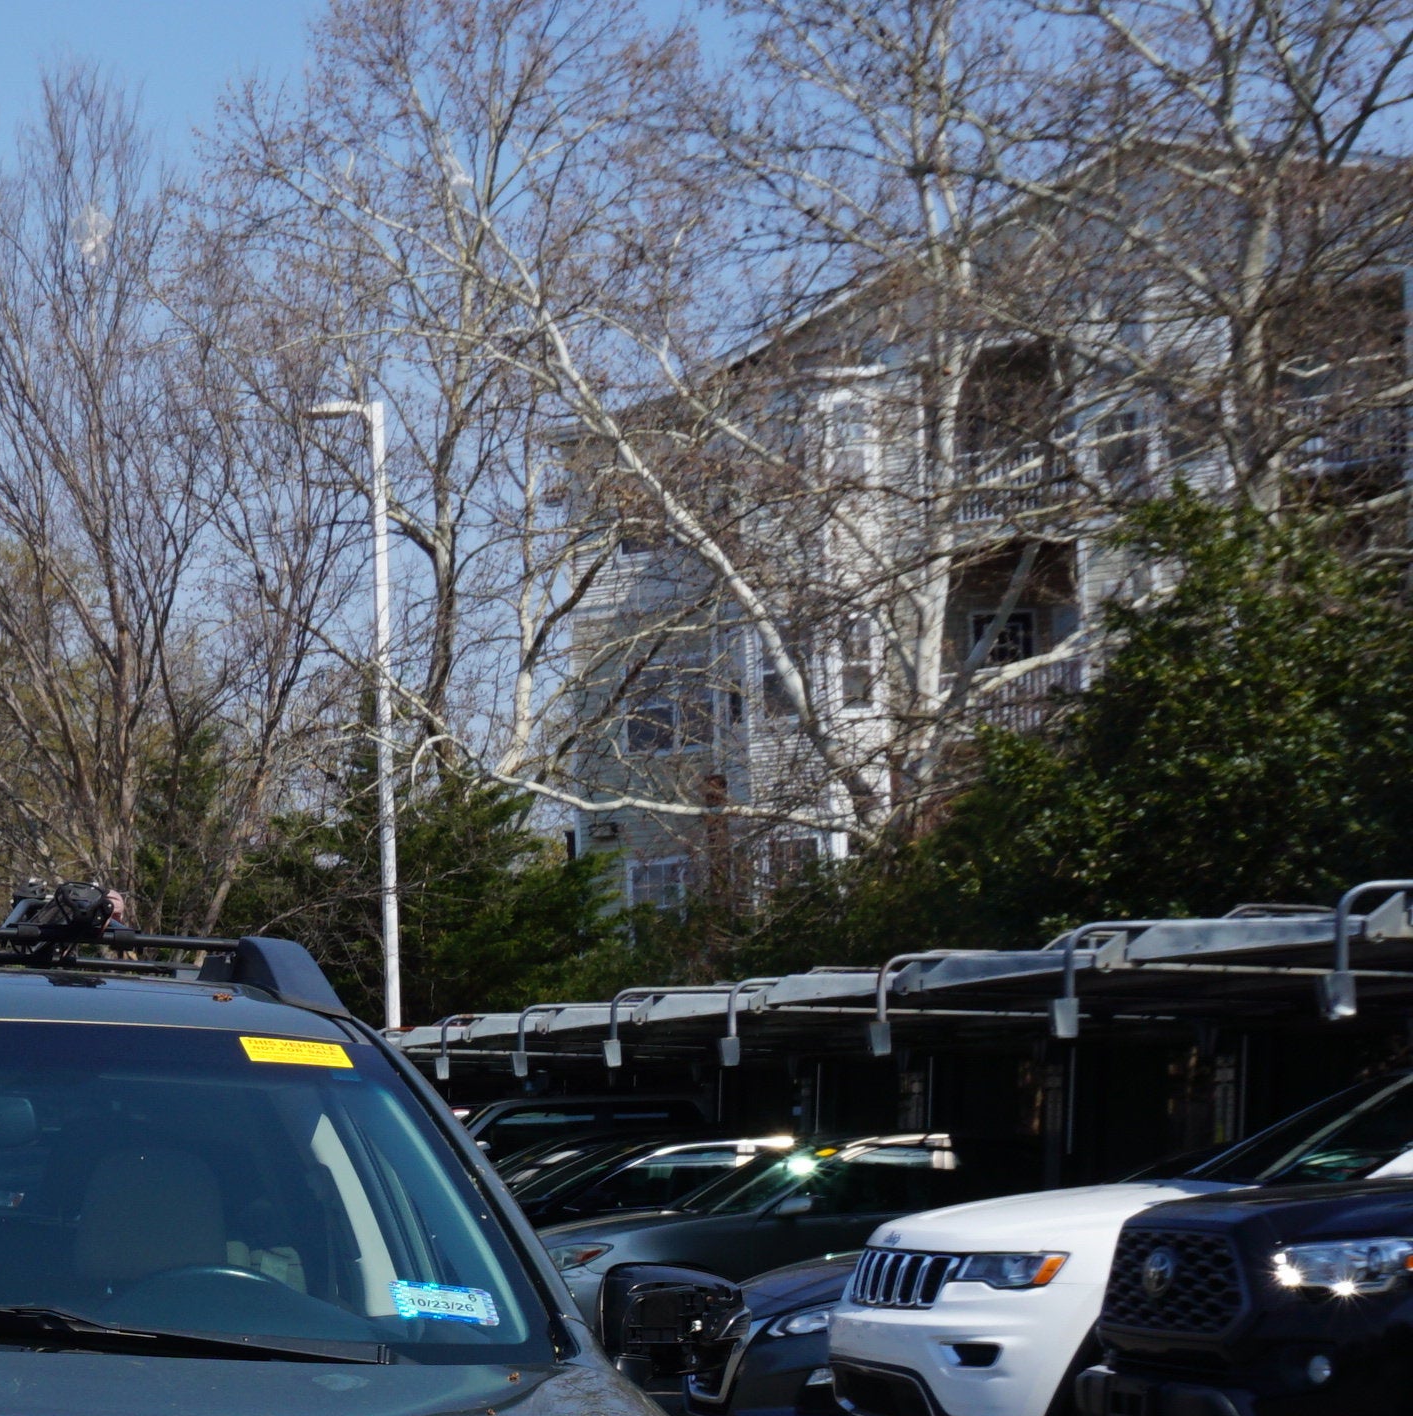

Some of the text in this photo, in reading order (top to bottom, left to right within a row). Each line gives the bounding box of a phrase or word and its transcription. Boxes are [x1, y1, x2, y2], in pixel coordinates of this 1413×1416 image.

[247, 1039, 338, 1051] THIS VEHICLE
[468, 1293, 477, 1303] 6
[408, 1298, 475, 1312] 10/23/26
